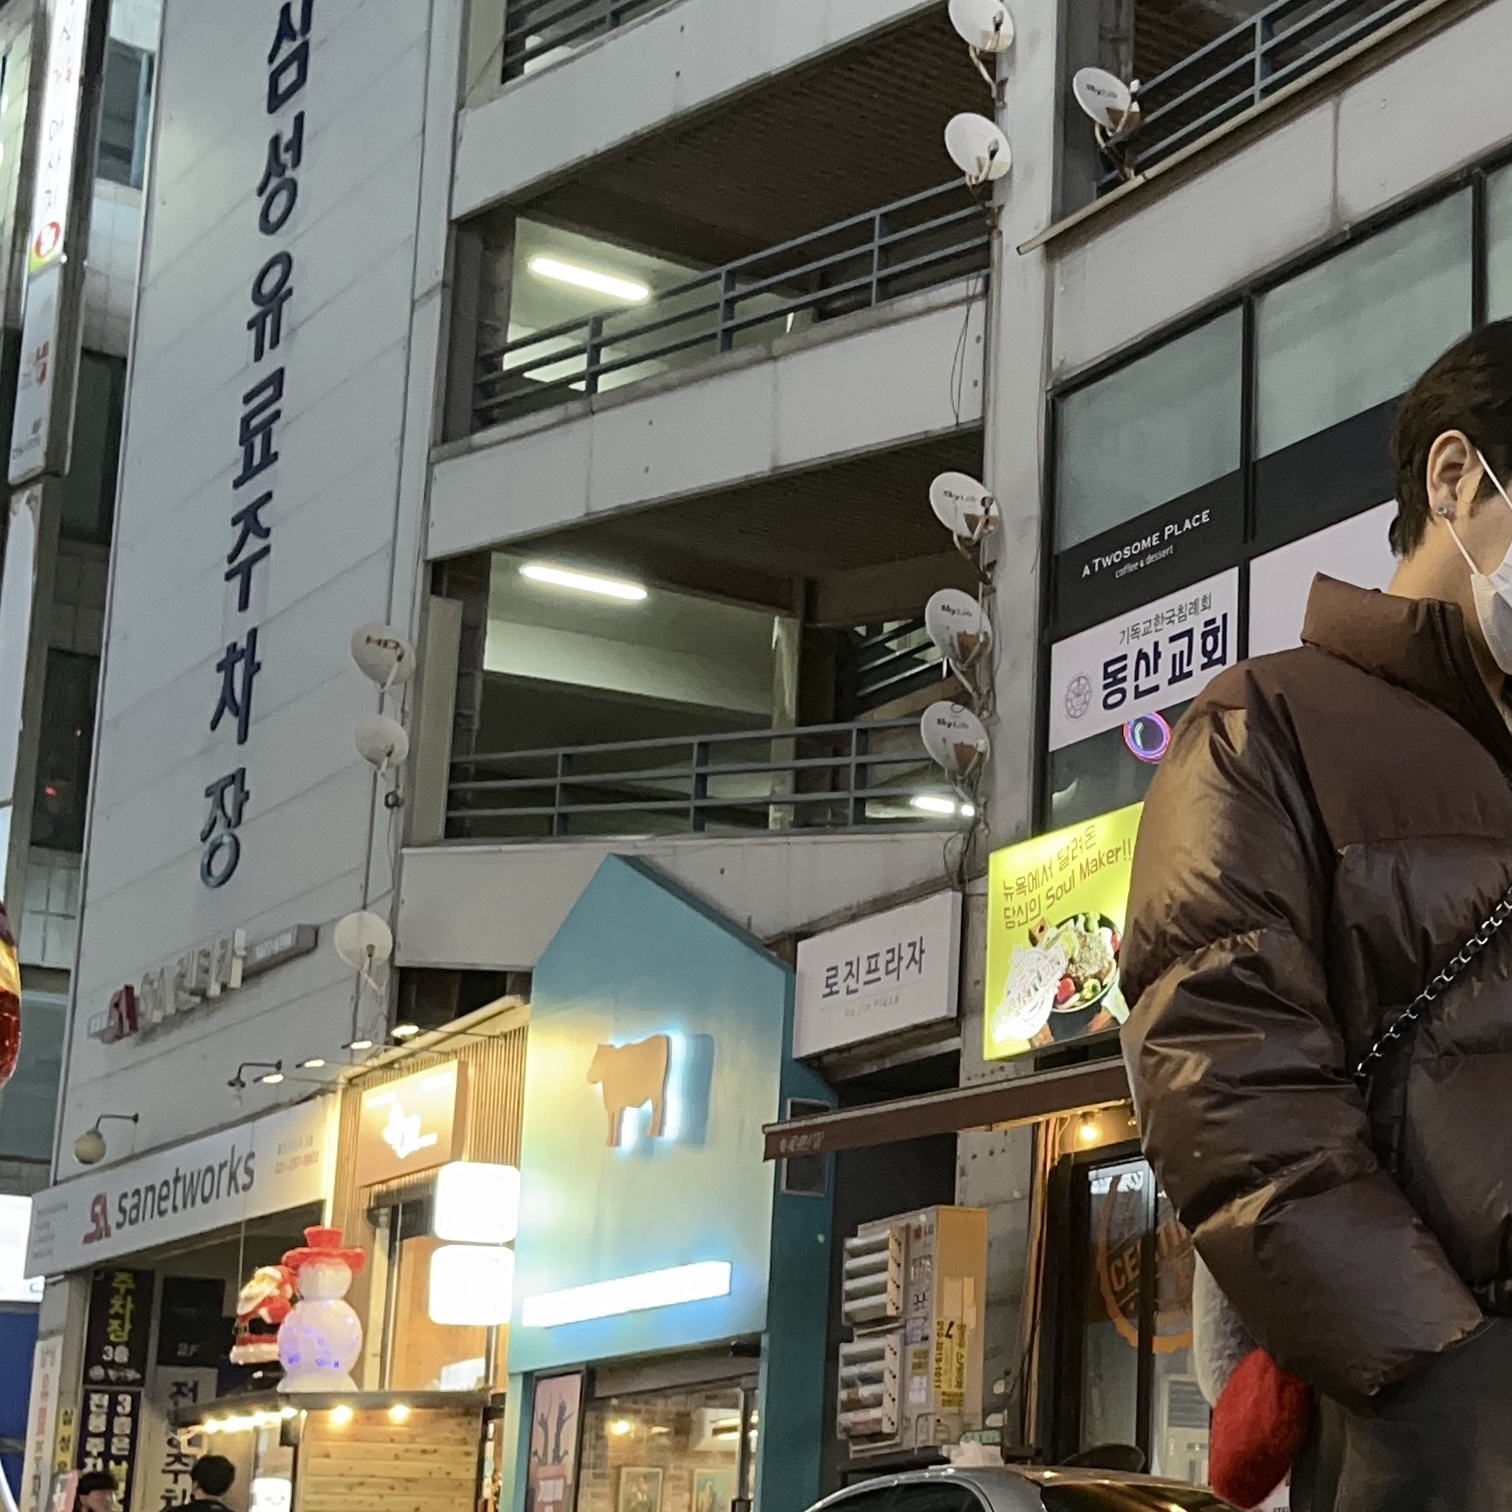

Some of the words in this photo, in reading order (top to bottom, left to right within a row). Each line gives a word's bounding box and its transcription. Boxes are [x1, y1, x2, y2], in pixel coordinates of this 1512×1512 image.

[1081, 564, 1091, 578] A
[1091, 532, 1160, 572] TWOSOME
[1164, 509, 1211, 540] PLACE
[1102, 612, 1228, 711] 동산교회
[1003, 858, 1054, 902] 뉴욕에서
[1058, 824, 1097, 873] 달려온
[1003, 894, 1042, 930] 당신의
[1046, 871, 1076, 911] Soul
[822, 936, 926, 999] 로진프라자
[115, 1145, 256, 1231] sanetworks
